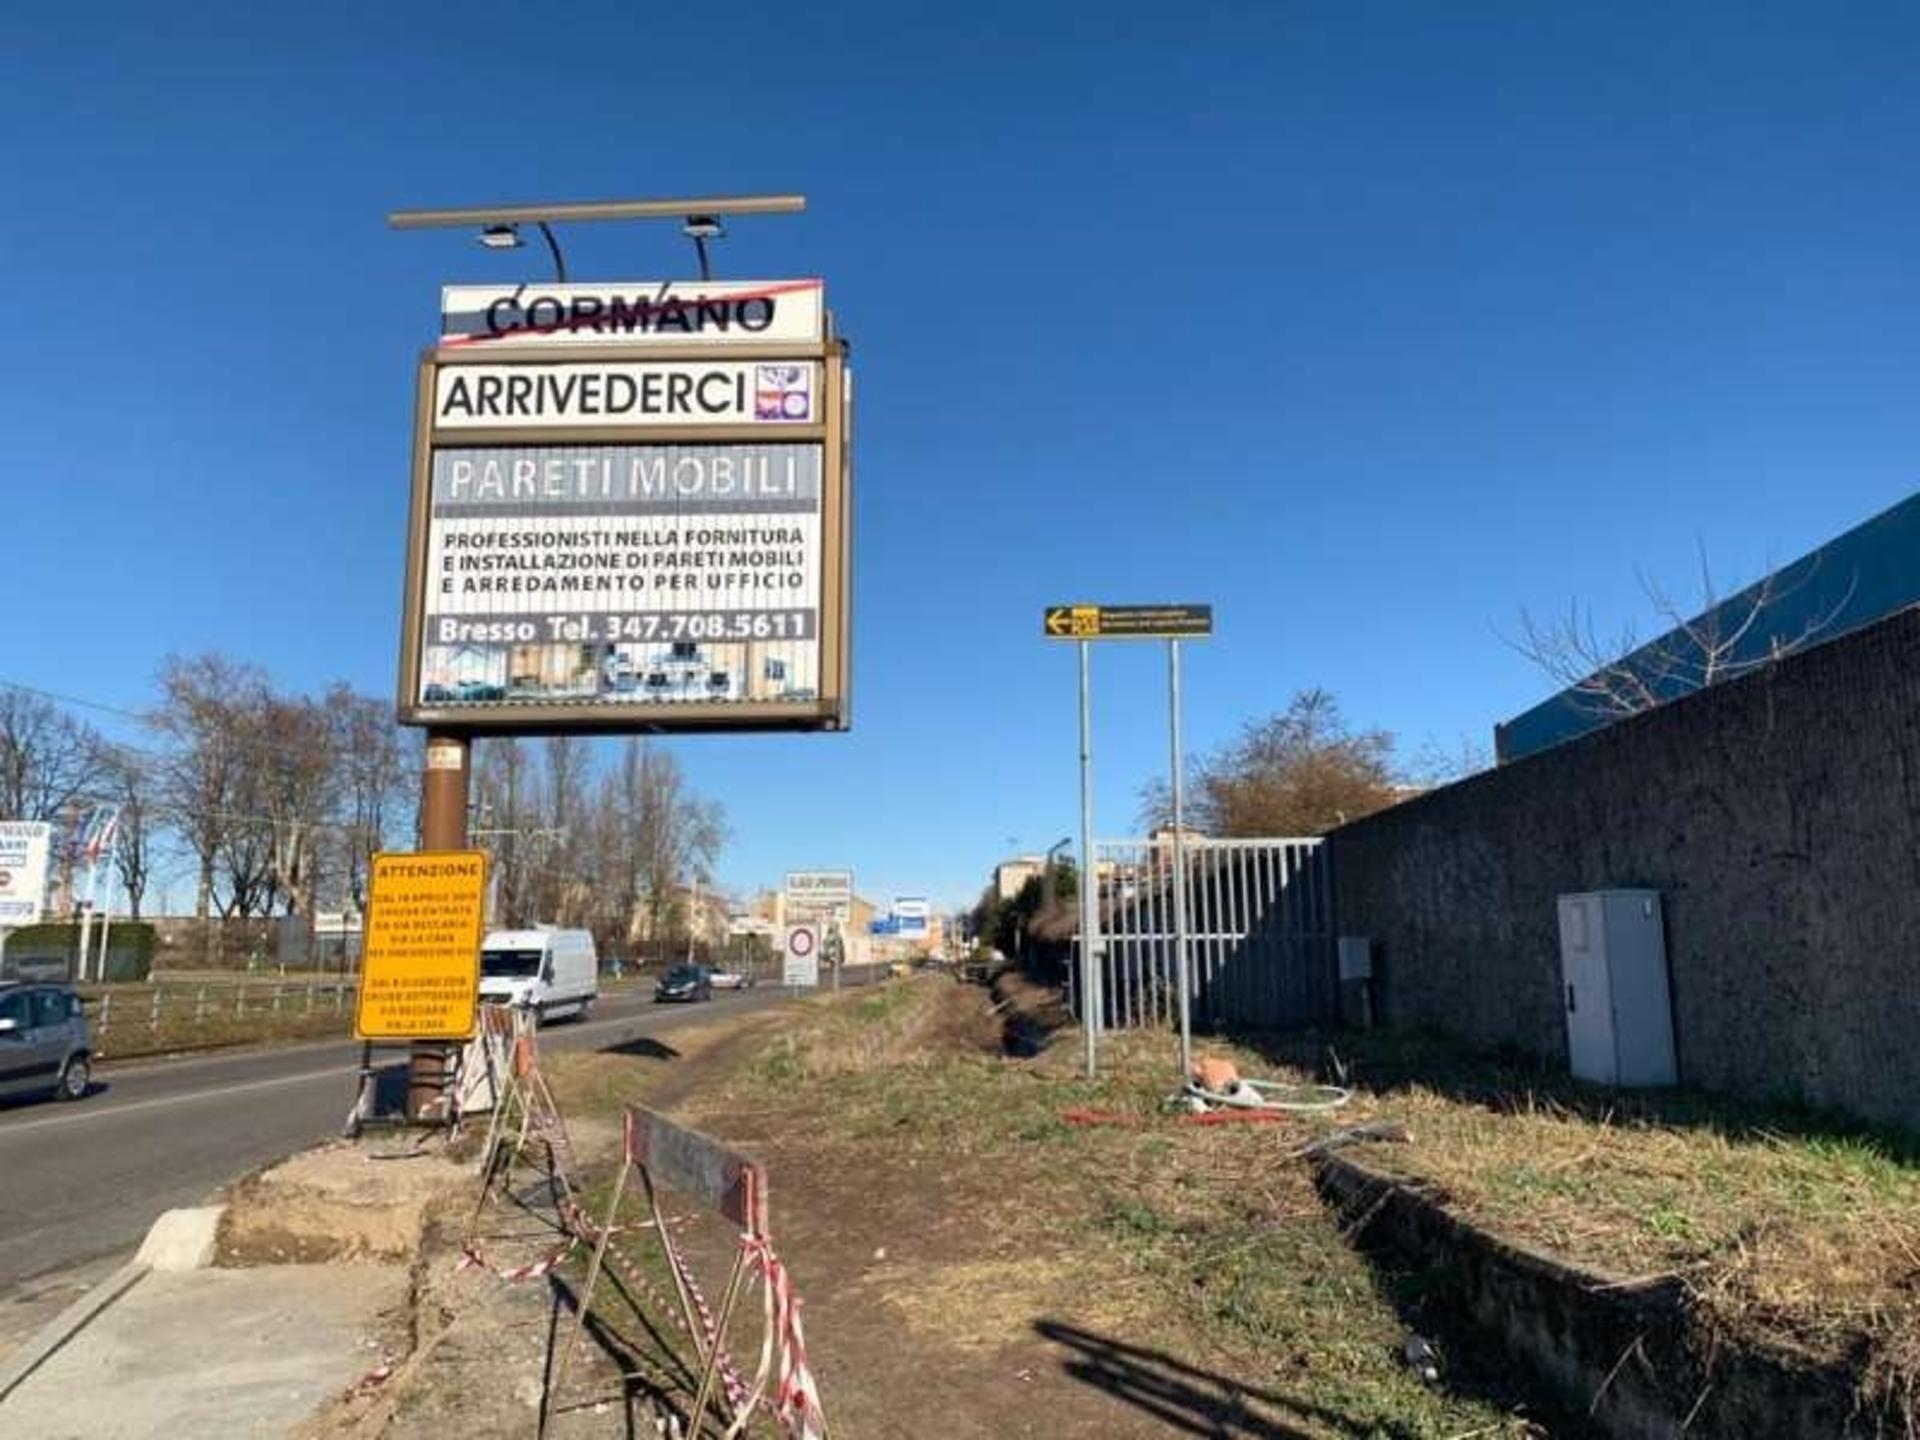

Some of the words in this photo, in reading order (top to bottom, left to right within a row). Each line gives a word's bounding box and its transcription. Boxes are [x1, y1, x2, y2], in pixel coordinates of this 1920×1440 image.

[485, 293, 777, 335] CORMANO
[441, 370, 746, 416] ARRIVEDERCI
[450, 457, 611, 498] PARETI
[629, 455, 796, 497] MOBILI
[444, 530, 611, 550] PROFESSIONISTI
[615, 529, 679, 547] NELLA
[685, 527, 804, 546] FORNITURA
[443, 556, 454, 572] E
[458, 552, 622, 571] INSTALLAZIONE
[626, 552, 648, 569] DI
[653, 551, 725, 568] PARETI
[729, 550, 803, 568] MOBILI
[442, 577, 453, 594] E
[463, 572, 645, 594] ARREDAMENTO
[654, 572, 699, 590] PER
[707, 571, 803, 590] UFFICIO
[439, 618, 536, 642] Bresso
[547, 615, 597, 640] Tel.
[605, 613, 805, 639] 347.708.5611
[379, 863, 479, 878] ATTENZIONE
